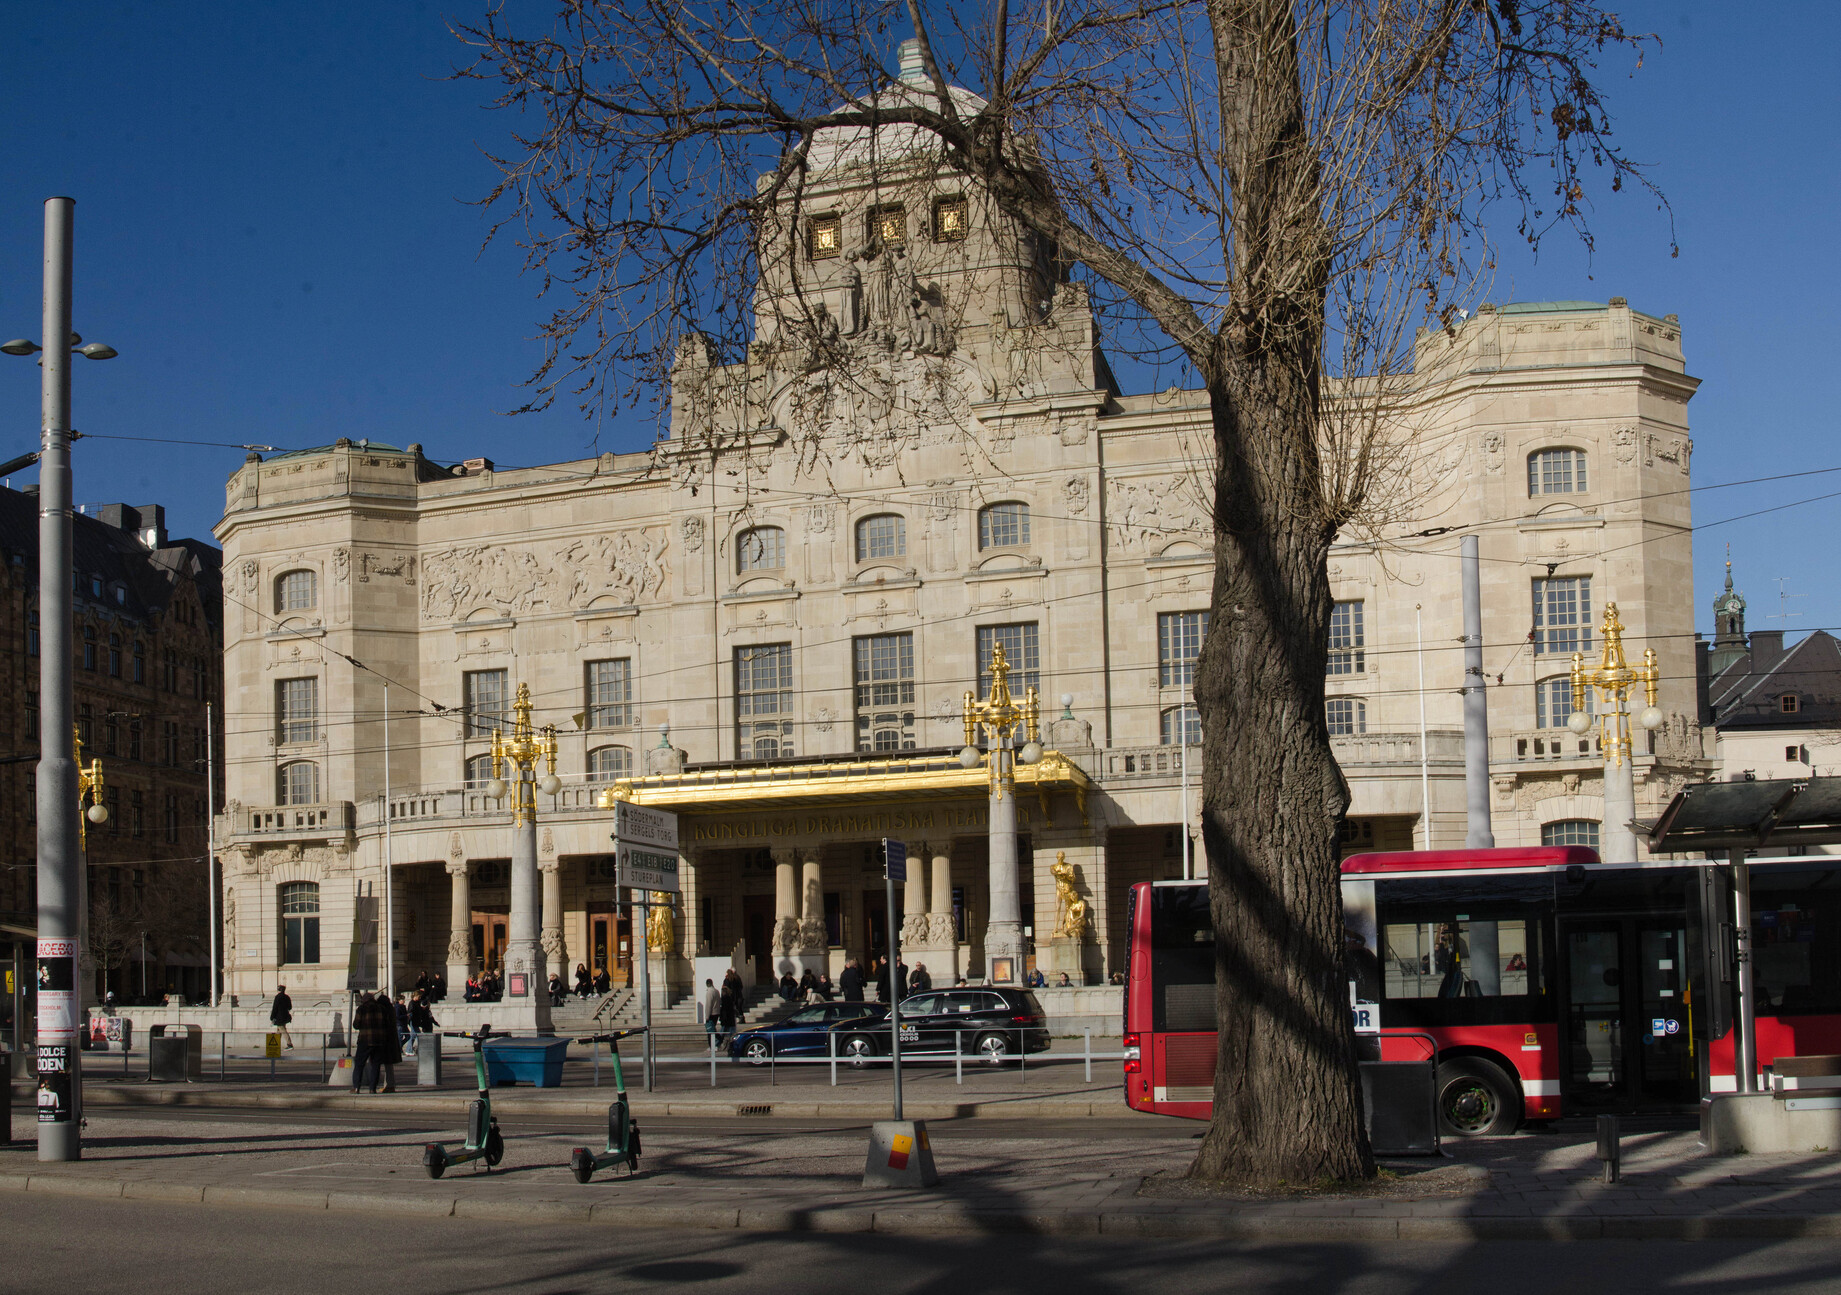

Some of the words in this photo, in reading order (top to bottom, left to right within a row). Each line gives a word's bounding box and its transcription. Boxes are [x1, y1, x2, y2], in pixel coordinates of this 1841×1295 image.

[629, 809, 664, 827] SÖDERMALM
[695, 818, 798, 840] KUNGLIGA
[805, 809, 934, 834] DRAMATISKA
[943, 807, 1031, 827] TEATN
[630, 824, 655, 838] SERGELS
[657, 829, 672, 842] TORG
[633, 853, 642, 865] E4
[647, 855, 658, 867] E18
[663, 858, 675, 870] E20
[630, 871, 664, 885] STUREPLAN
[40, 1047, 67, 1057] DOLCE
